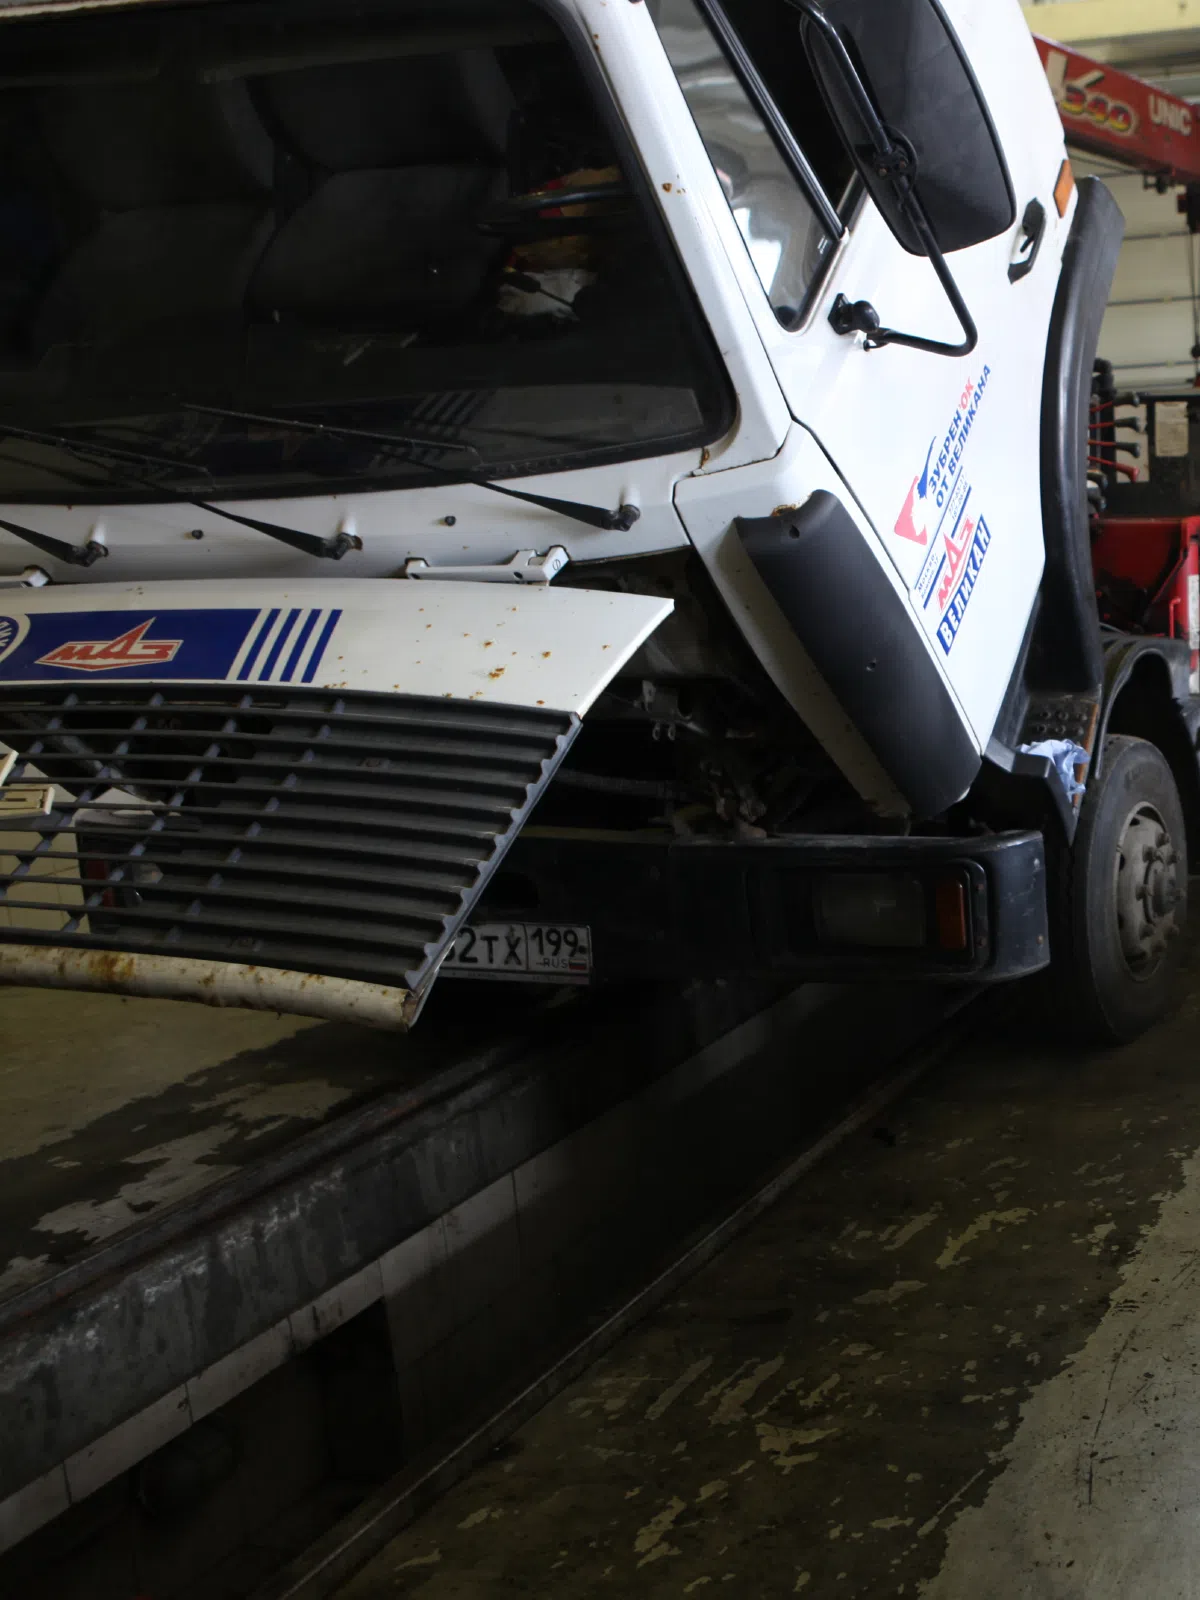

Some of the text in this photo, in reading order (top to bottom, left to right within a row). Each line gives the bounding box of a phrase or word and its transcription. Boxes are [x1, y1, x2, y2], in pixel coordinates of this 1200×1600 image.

[1148, 94, 1192, 136] UNIC
[936, 474, 949, 508] ОТ
[948, 364, 991, 476] ВЕЛИКАНА
[939, 518, 989, 650] ВЕЛИКАН
[531, 927, 579, 957] 199
[542, 957, 568, 969] RUS
